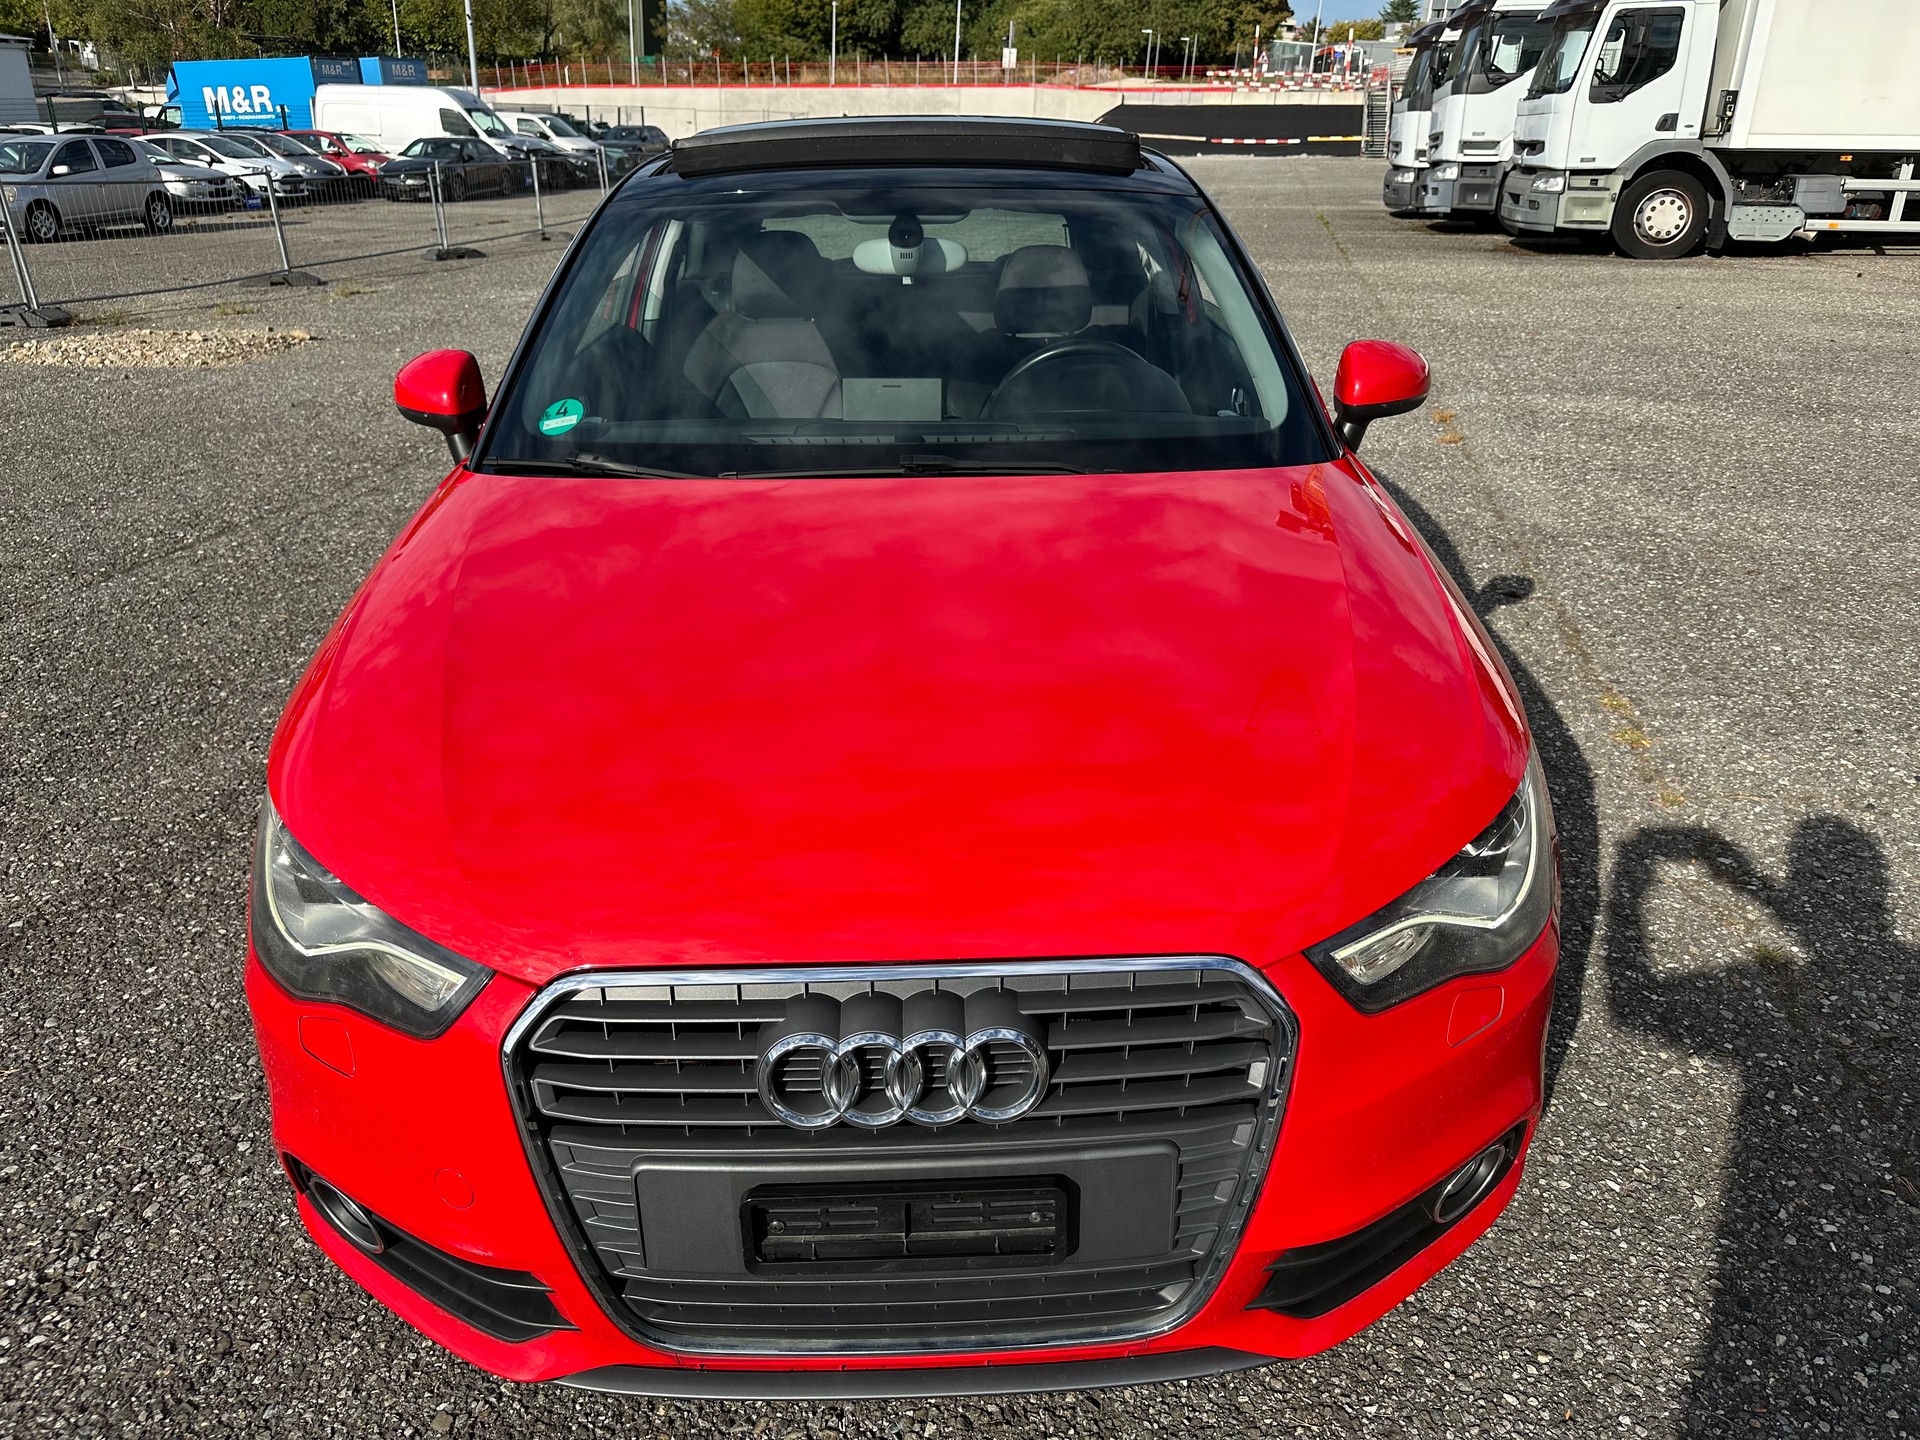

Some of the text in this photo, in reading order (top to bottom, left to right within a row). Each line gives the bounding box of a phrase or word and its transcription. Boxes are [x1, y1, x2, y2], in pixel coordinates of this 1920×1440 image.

[322, 64, 343, 75] M&R
[391, 64, 416, 76] M&R
[202, 85, 274, 114] M&R
[556, 401, 569, 416] 4
